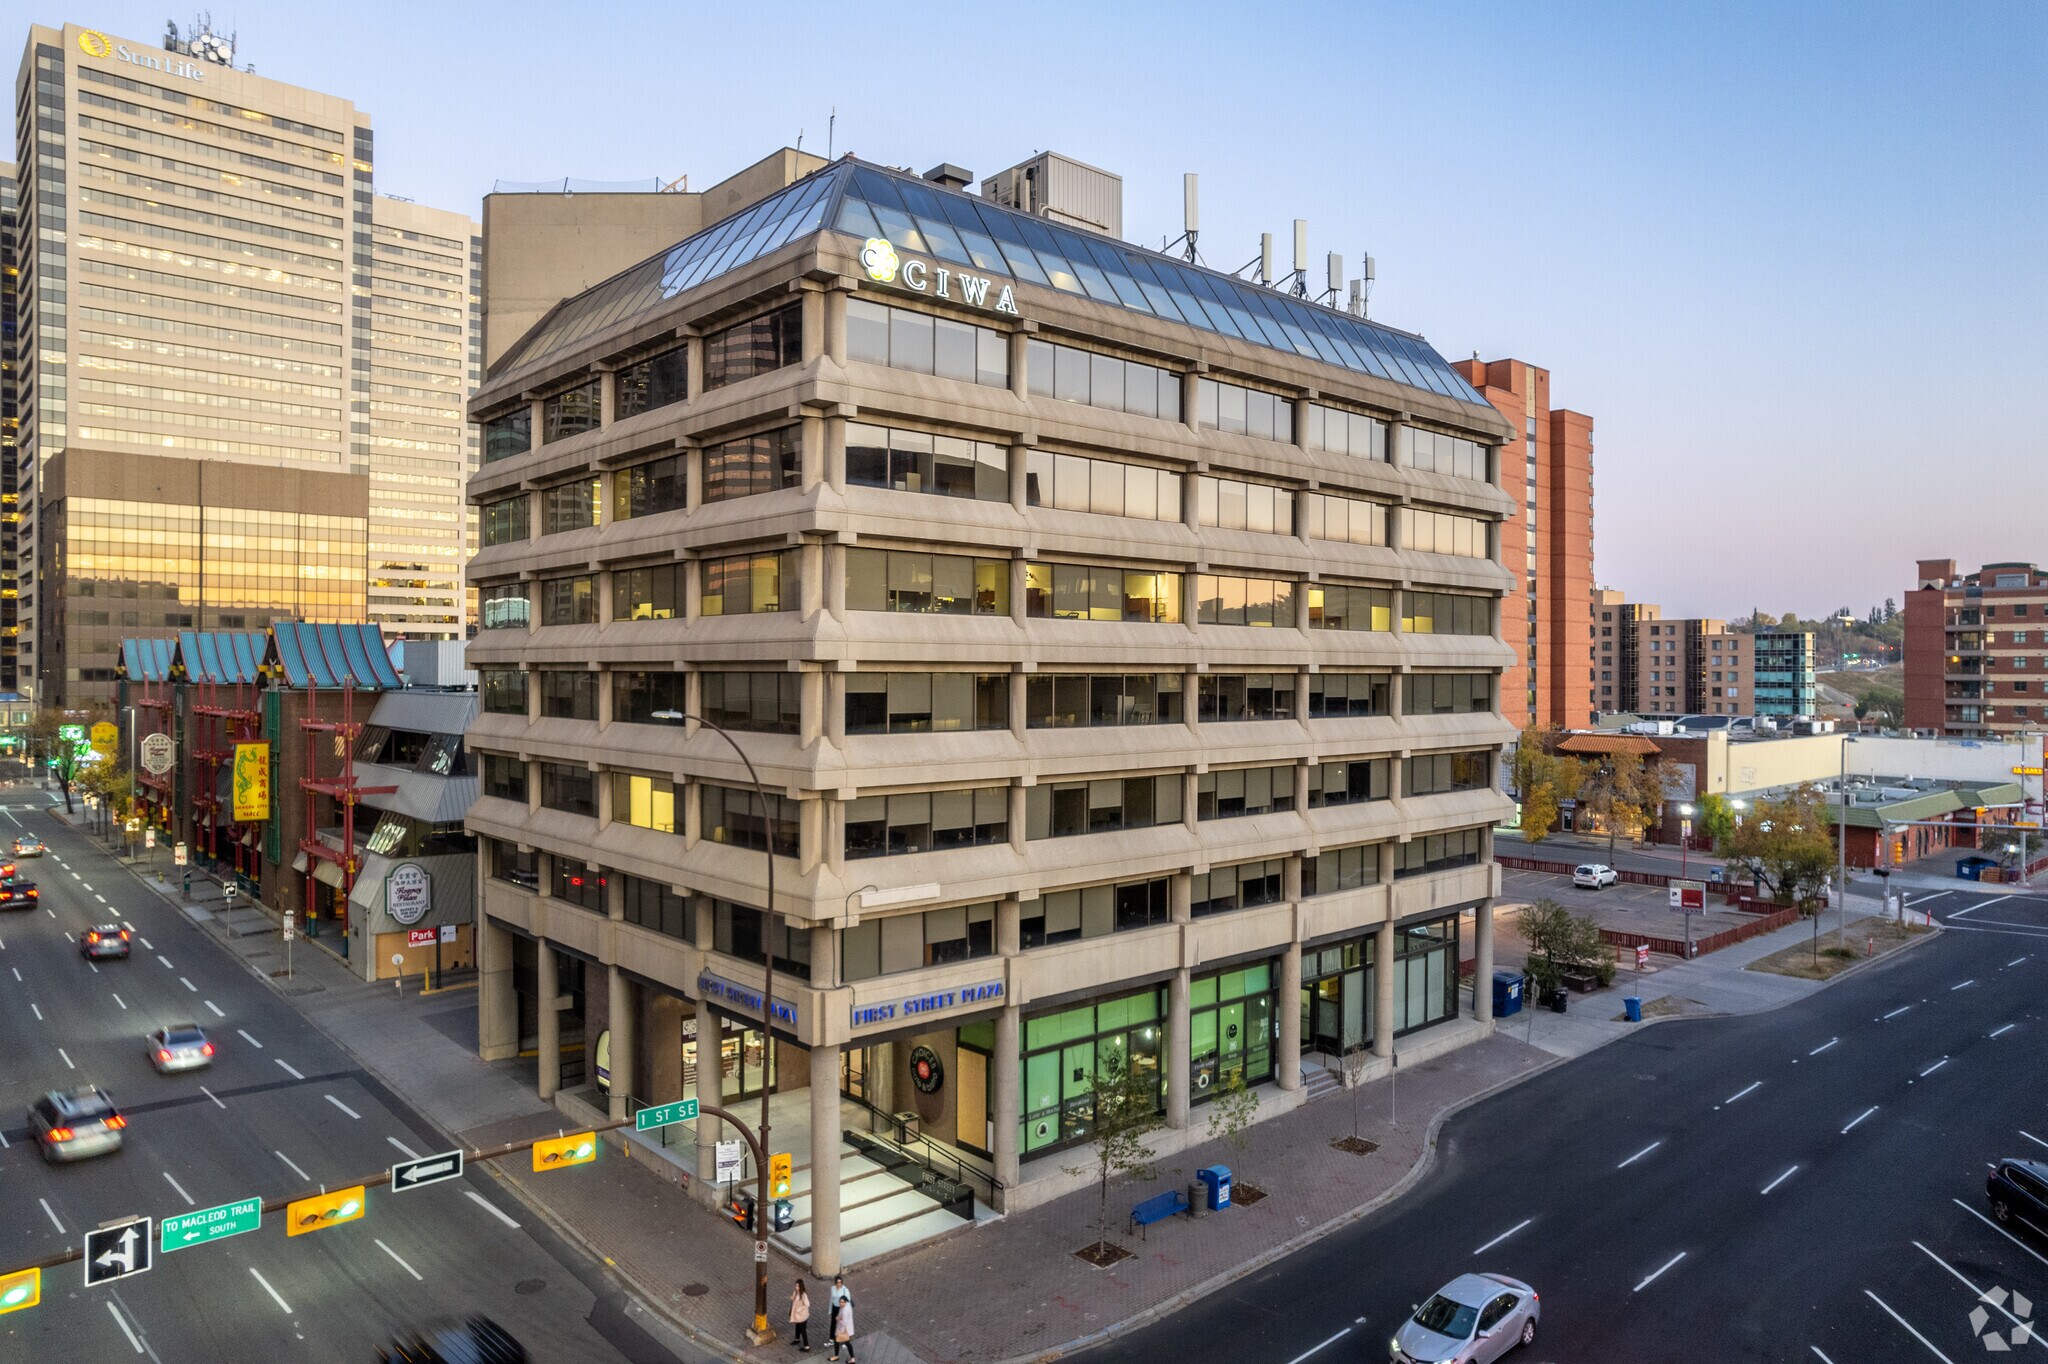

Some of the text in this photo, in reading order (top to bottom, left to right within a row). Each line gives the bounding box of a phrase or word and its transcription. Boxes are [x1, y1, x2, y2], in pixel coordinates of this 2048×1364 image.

[117, 45, 205, 81] Sun Life
[901, 259, 1019, 315] CIWA
[395, 886, 422, 897] Regency
[396, 894, 418, 902] Palace
[393, 900, 425, 908] RESTAURANT
[411, 930, 434, 941] Park
[854, 983, 1004, 1025] FIRST STREET PLAZA
[641, 1103, 695, 1126] 1 ST SE
[166, 1203, 255, 1233] TO MACLEOD TRAIL
[209, 1221, 237, 1236] SOUTH
